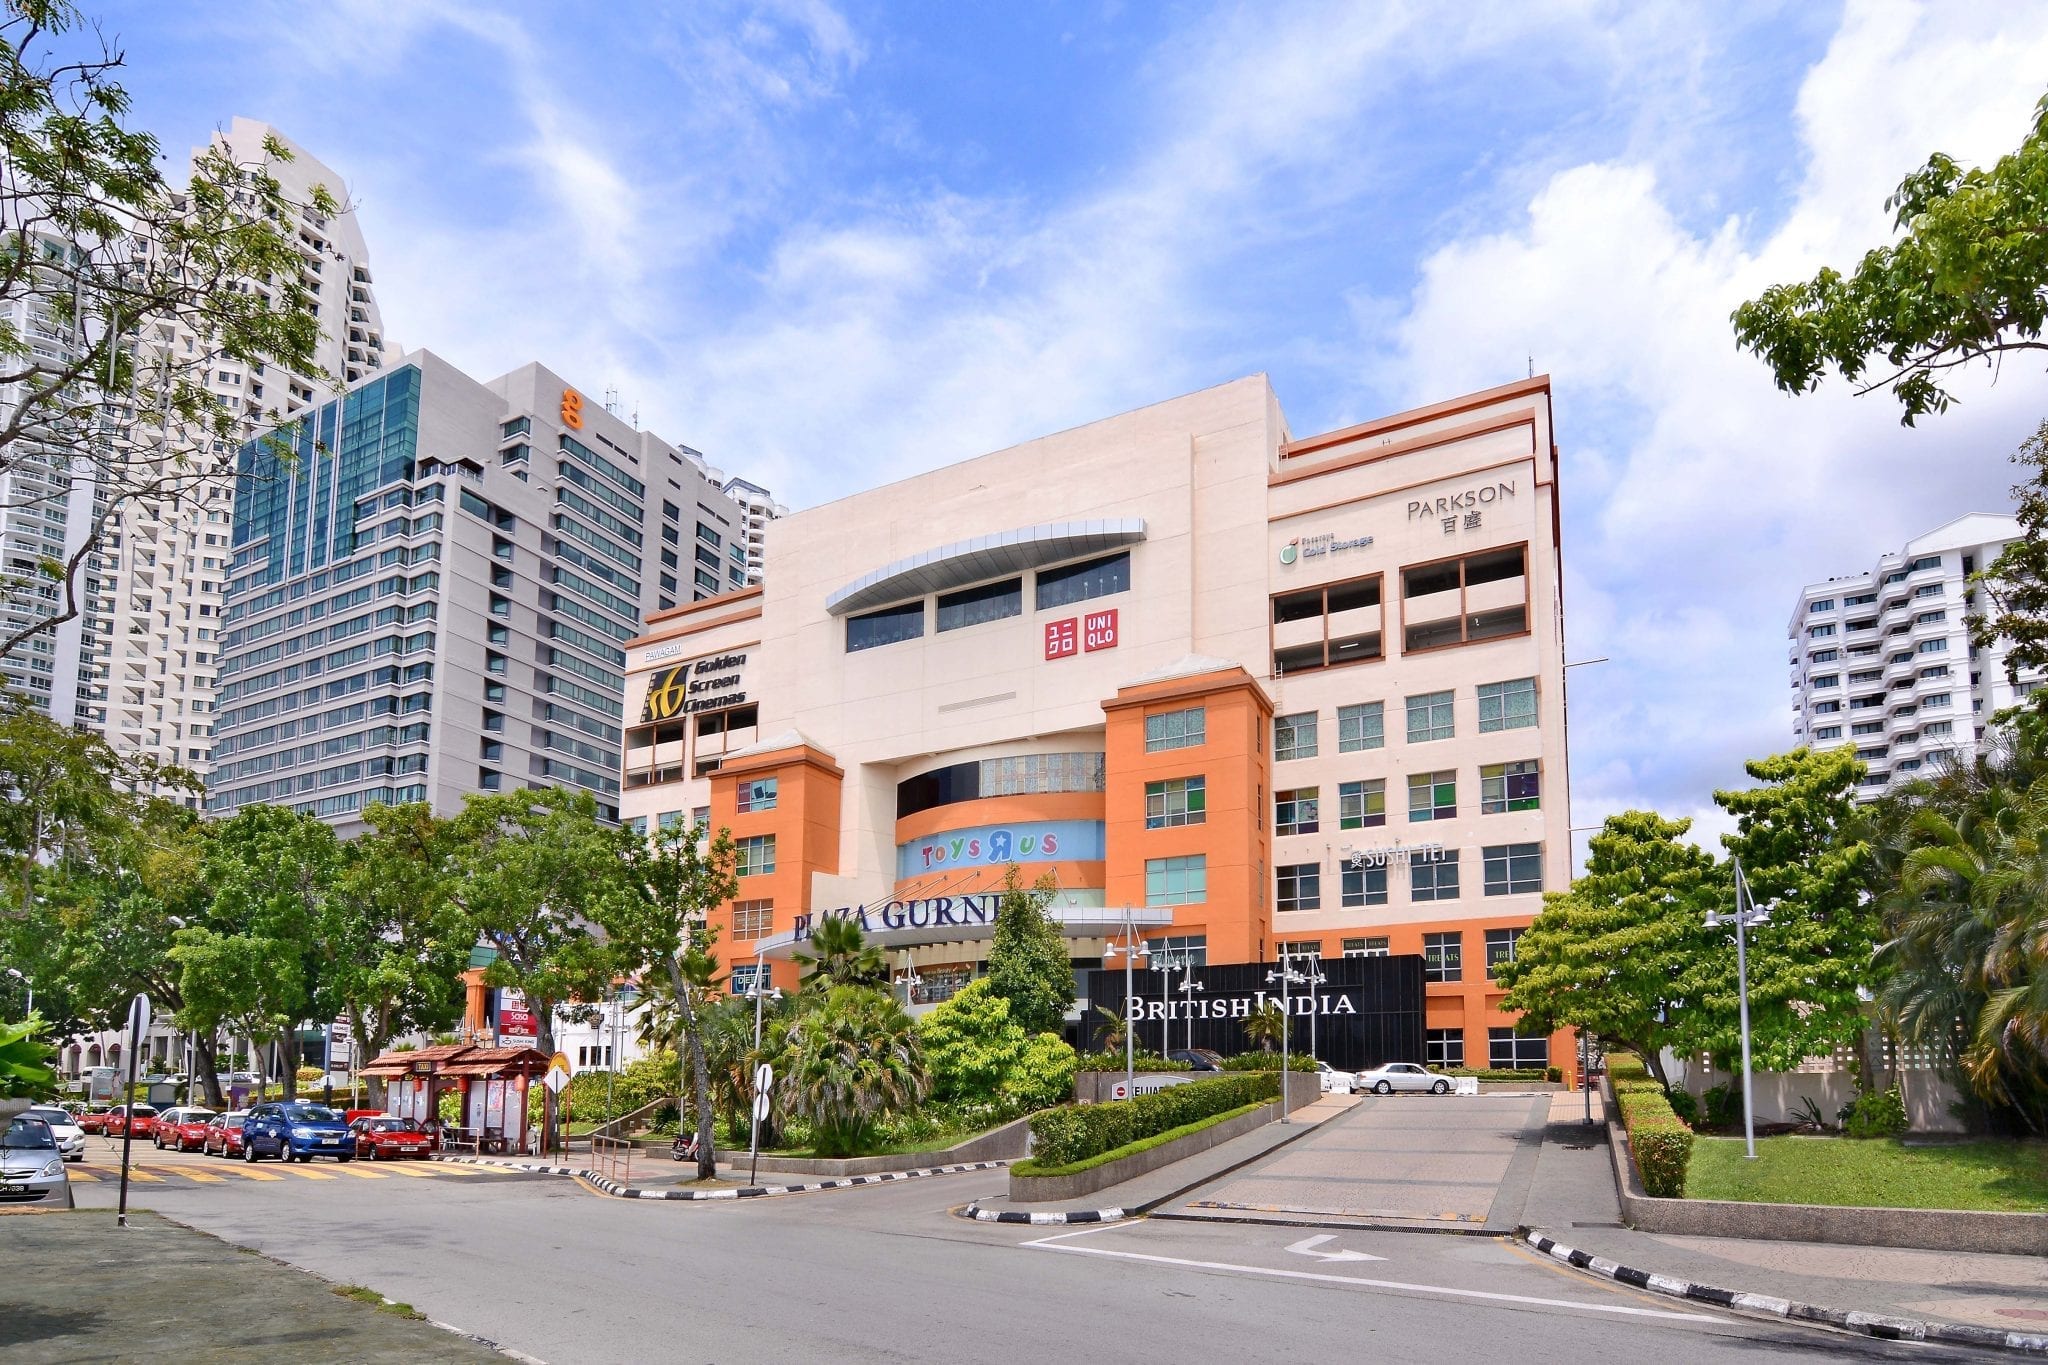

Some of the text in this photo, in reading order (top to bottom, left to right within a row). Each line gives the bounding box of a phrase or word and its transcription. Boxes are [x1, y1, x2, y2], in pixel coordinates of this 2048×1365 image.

[1408, 480, 1516, 520] PARKSON
[1441, 510, 1482, 535] 百盛
[1303, 536, 1373, 558] Cold Storage
[645, 645, 681, 661] PAWAGAM
[694, 653, 747, 675] Golden
[688, 674, 741, 694] Screen
[682, 691, 747, 714] Cinemas
[1366, 847, 1412, 868] SUSHI
[1422, 843, 1447, 862] TEI
[882, 893, 1037, 930] GURN
[1428, 953, 1459, 962] TREATS
[417, 1062, 430, 1071] TAXI
